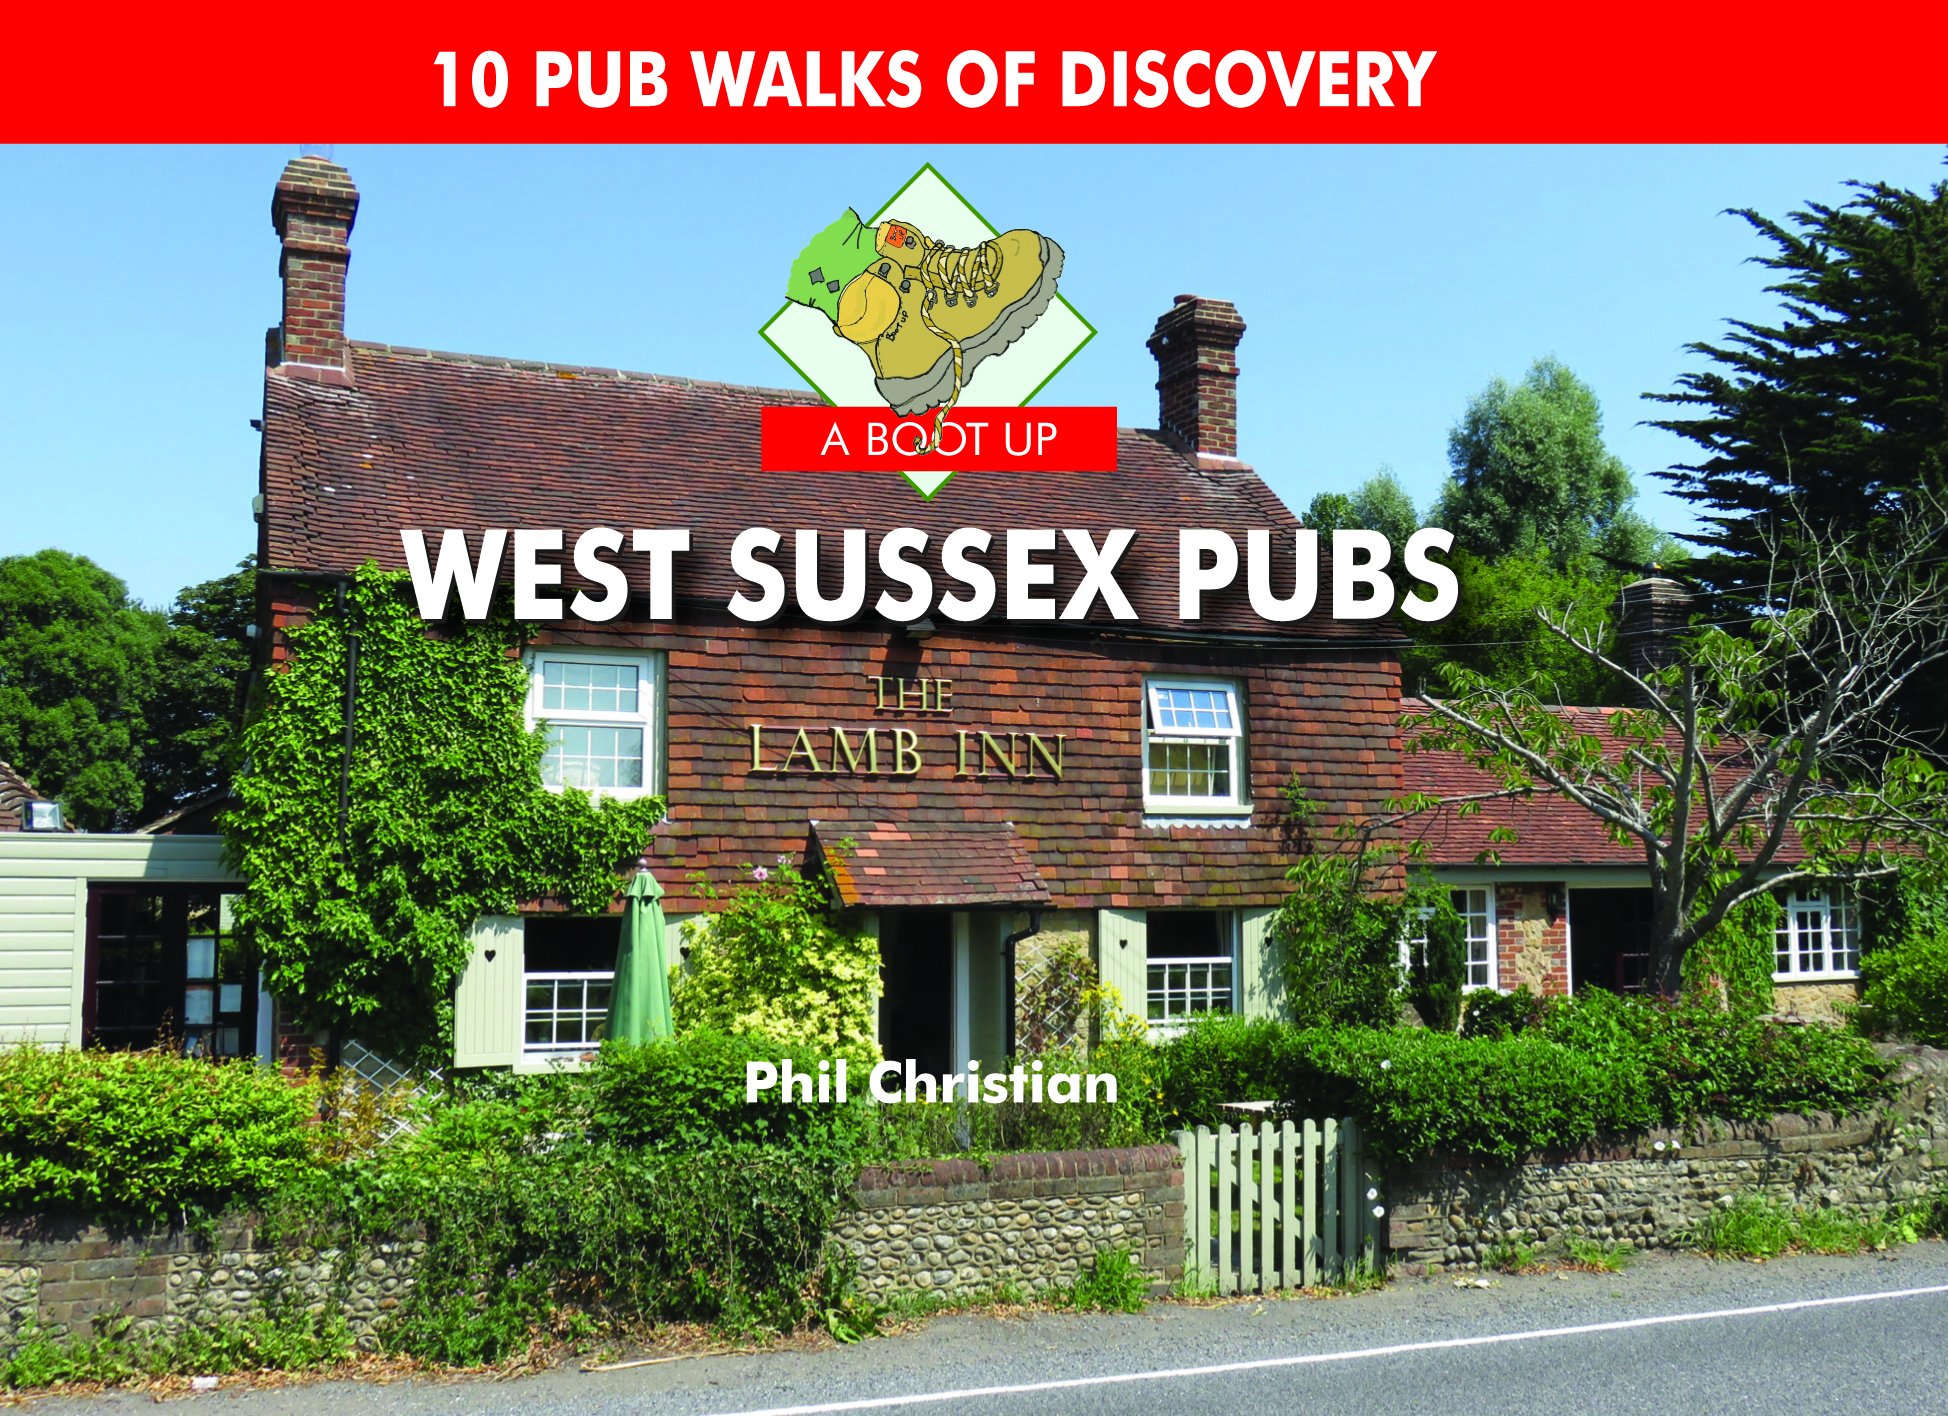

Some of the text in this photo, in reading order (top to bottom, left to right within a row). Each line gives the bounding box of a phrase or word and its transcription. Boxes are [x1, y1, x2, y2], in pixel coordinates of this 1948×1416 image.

[868, 675, 953, 712] THE
[751, 724, 1067, 778] LAMB INN
